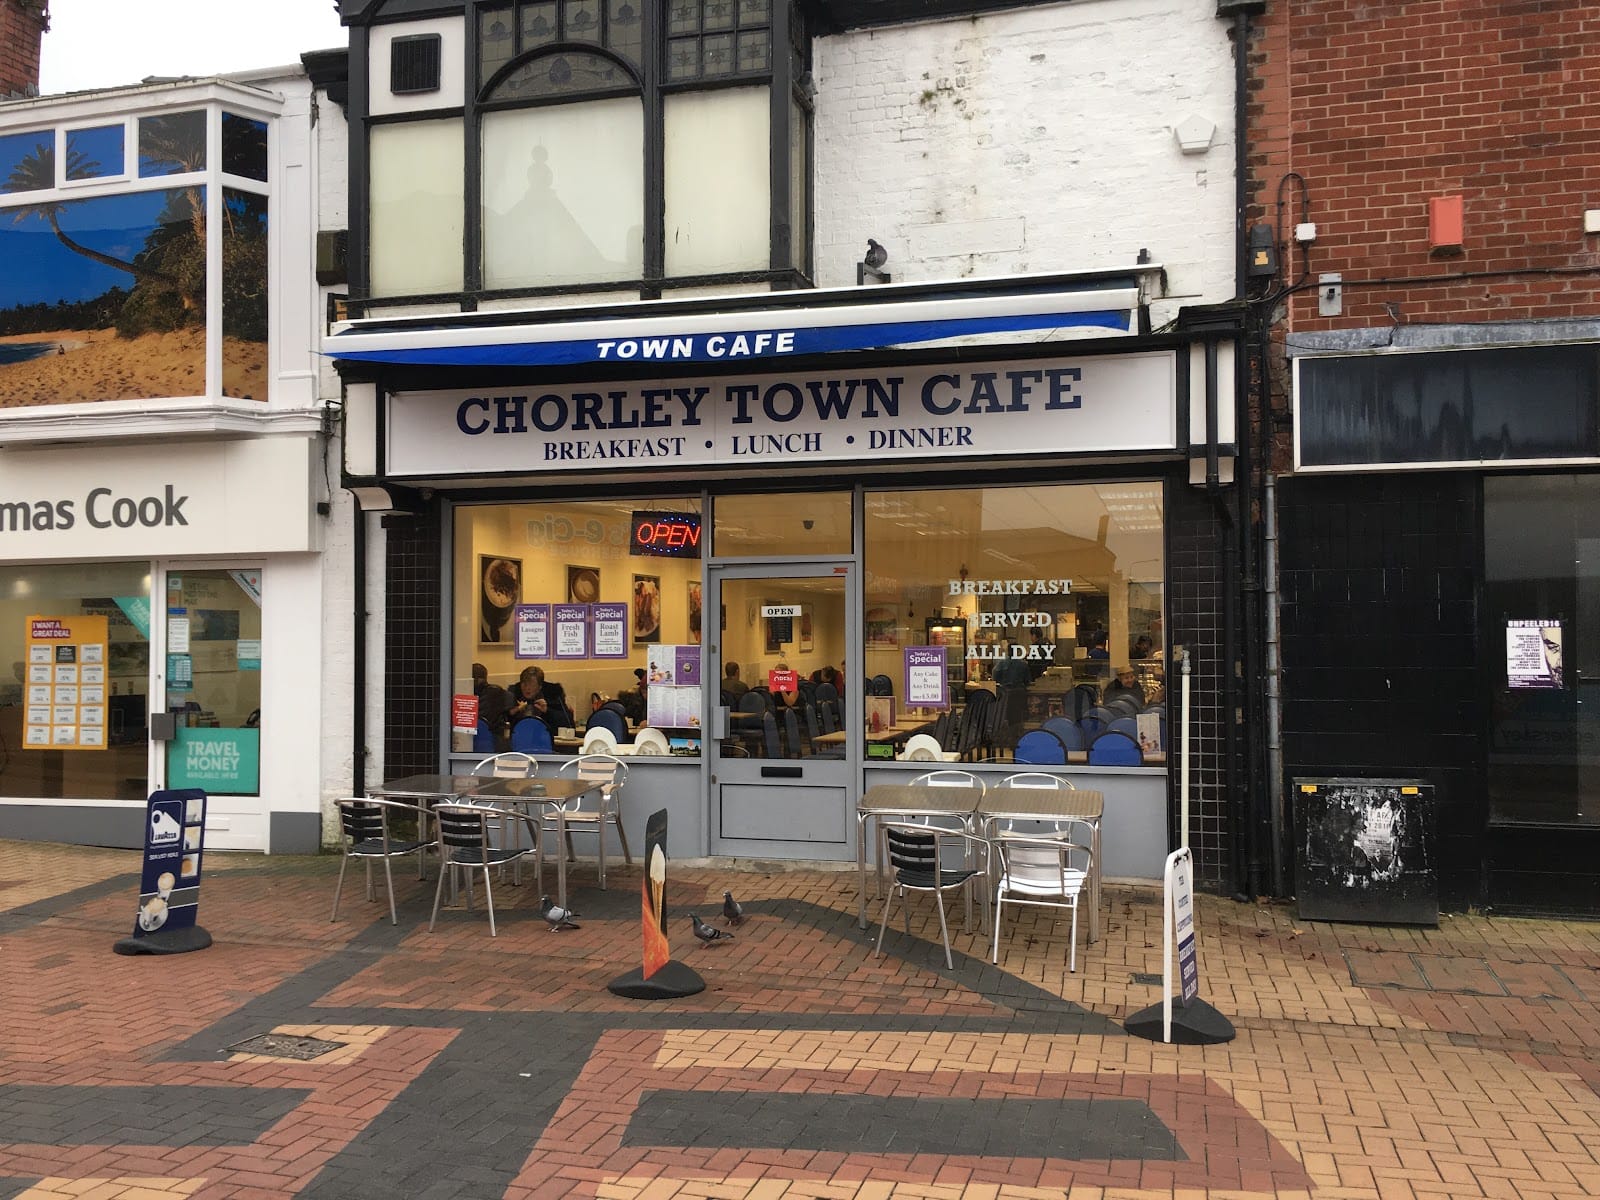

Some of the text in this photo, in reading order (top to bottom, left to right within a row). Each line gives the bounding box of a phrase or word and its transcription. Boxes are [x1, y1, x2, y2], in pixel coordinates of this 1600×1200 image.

[597, 332, 794, 359] TOWN CAFE
[456, 368, 1082, 435] CHORLEY TOWN CAFE
[543, 426, 973, 461] BREAKFAST LUNCH DINNER
[0, 484, 189, 531] mas Cook
[637, 523, 701, 546] OPEN
[949, 580, 1072, 595] BREAKFAST
[520, 611, 546, 620] Special
[557, 611, 584, 620] Special
[595, 610, 622, 620] Special
[968, 612, 1052, 628] SERVED
[910, 654, 941, 664] Special
[965, 645, 1056, 660] ALL DAY
[186, 742, 240, 756] TRAVEL
[186, 756, 239, 770] MONEY
